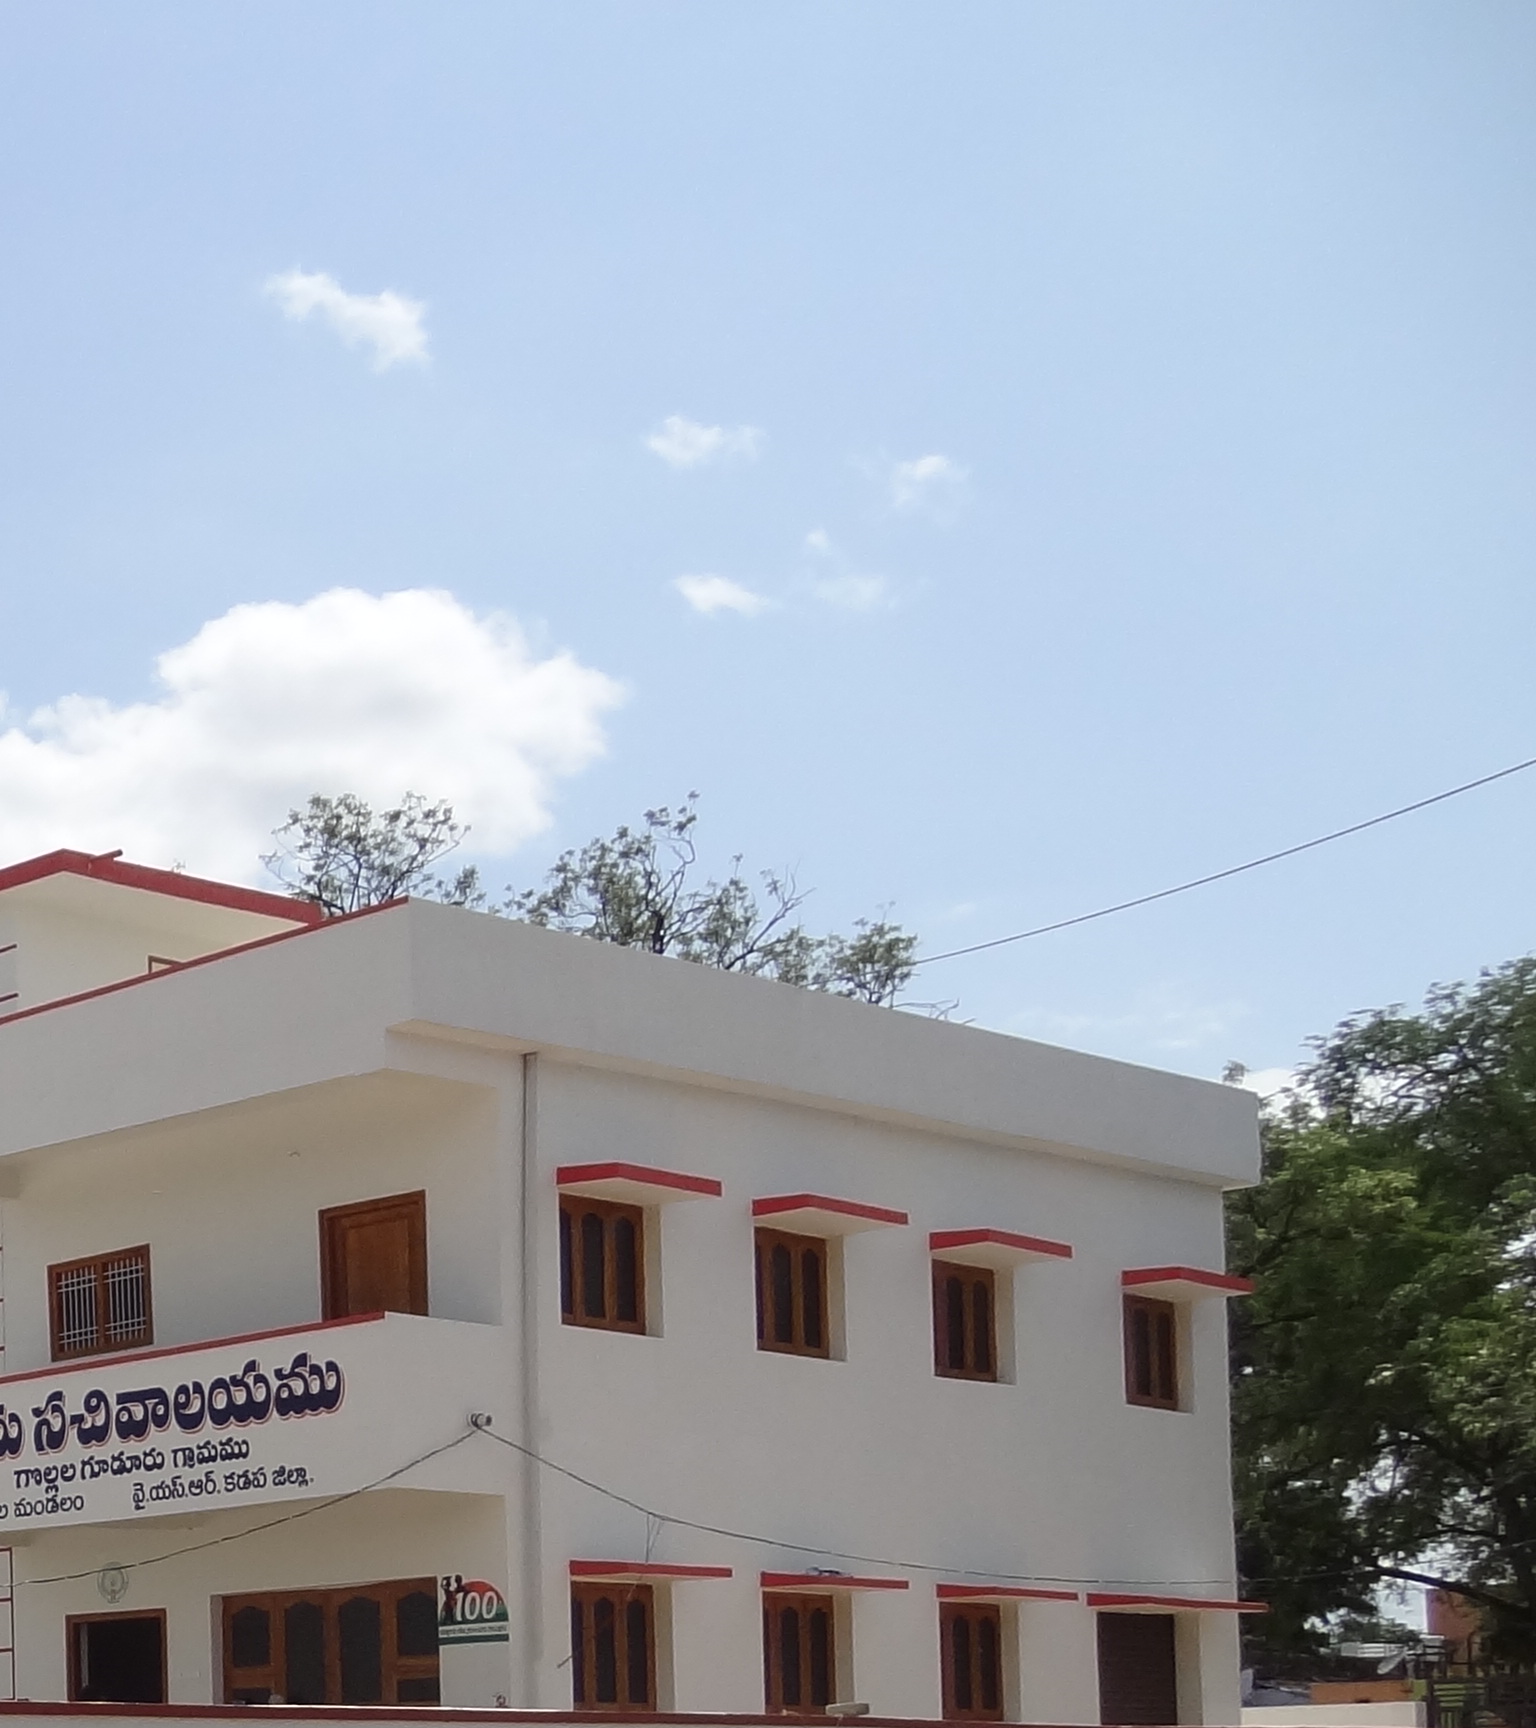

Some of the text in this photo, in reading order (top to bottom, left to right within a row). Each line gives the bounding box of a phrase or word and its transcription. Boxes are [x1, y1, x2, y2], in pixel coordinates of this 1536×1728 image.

[31, 1352, 348, 1453] సచివాలయము
[223, 1467, 267, 1493] కడప
[13, 1494, 85, 1519] మండలం
[456, 1591, 497, 1620] 100
